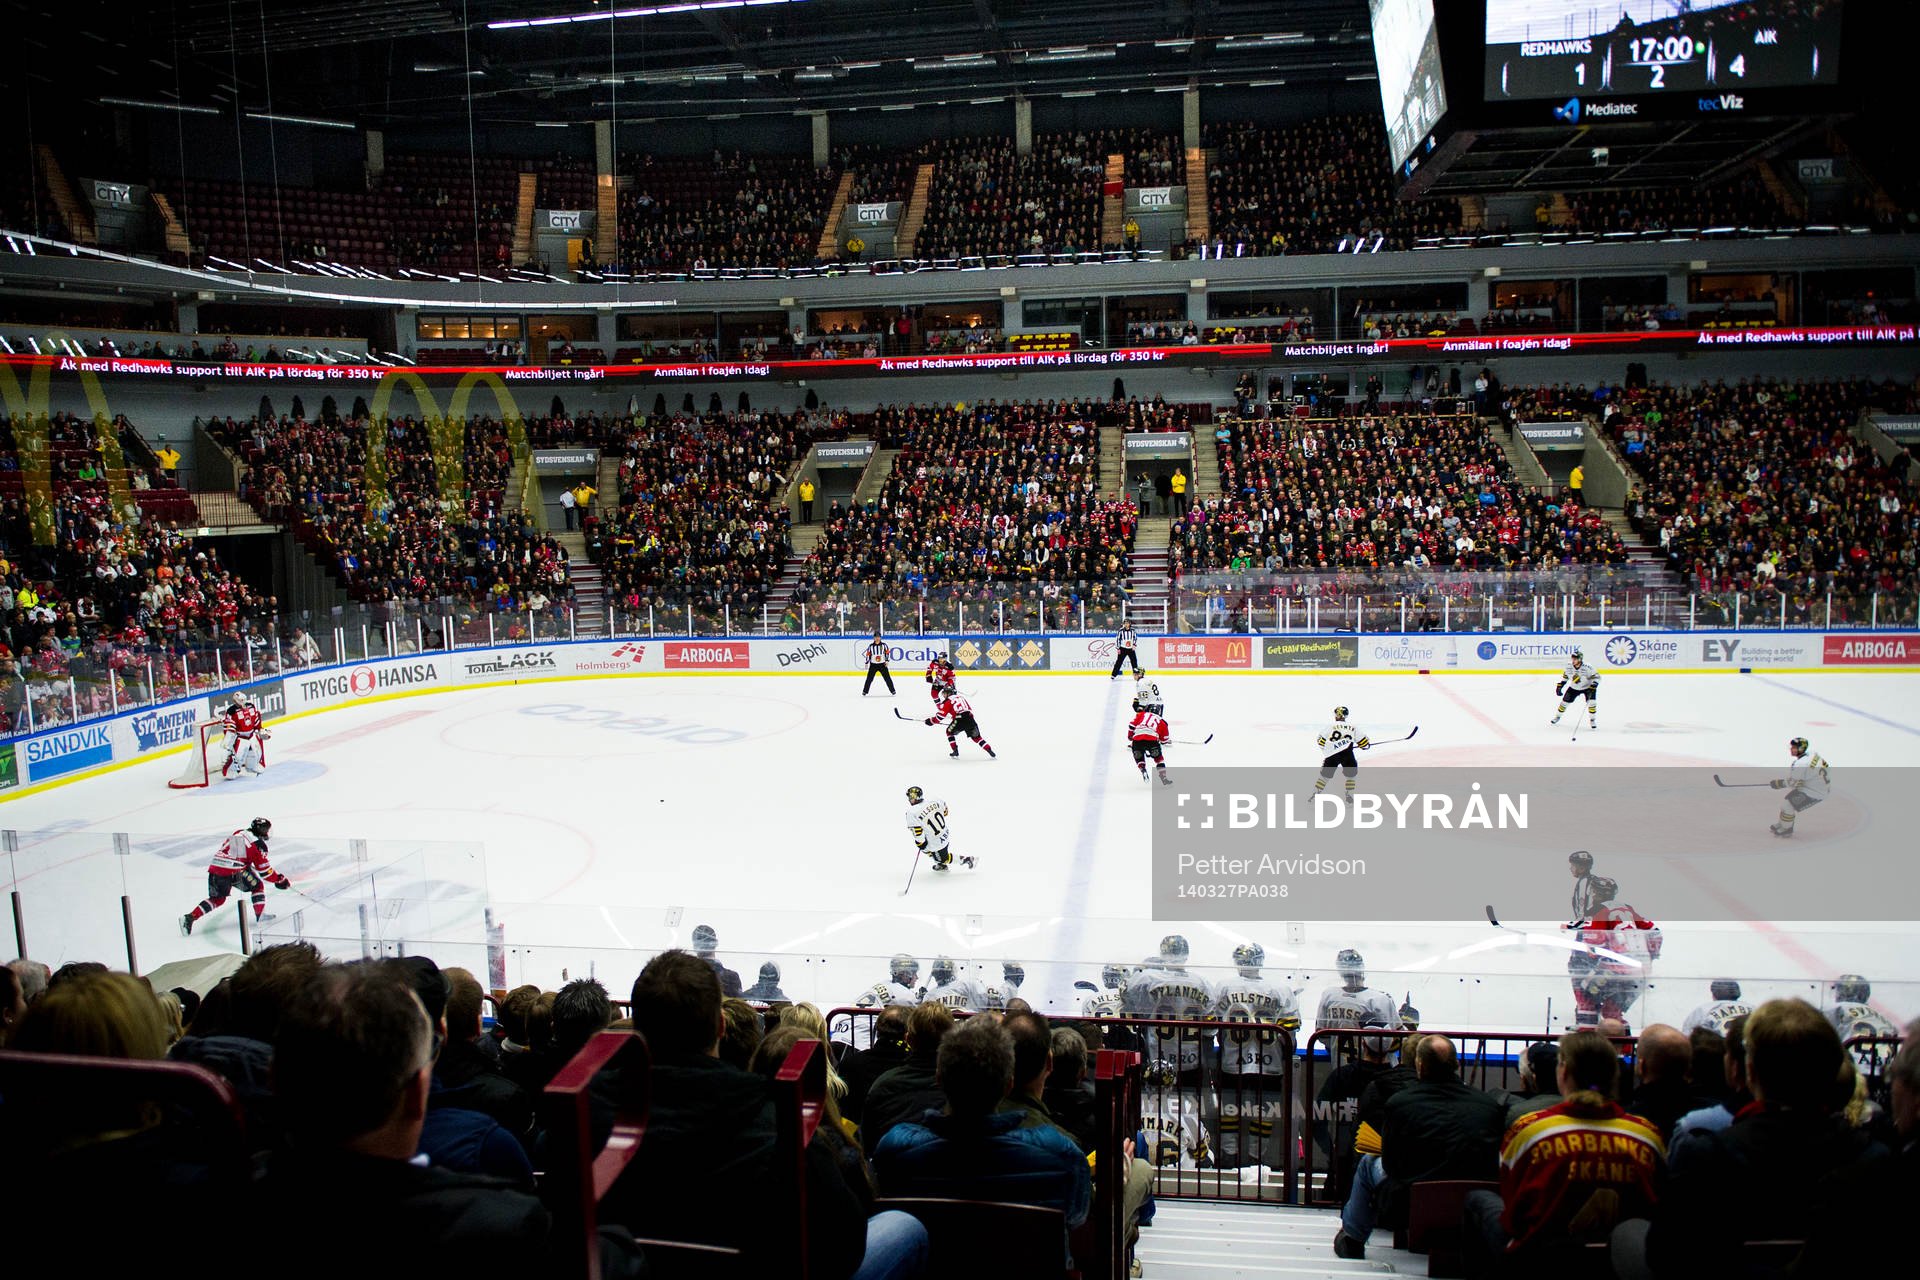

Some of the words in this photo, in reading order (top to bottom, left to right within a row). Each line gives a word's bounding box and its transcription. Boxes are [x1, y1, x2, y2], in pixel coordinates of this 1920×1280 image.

[1753, 29, 1778, 45] AIK
[1520, 40, 1592, 57] REDHAWKS
[1629, 36, 1694, 62] 17:00
[1729, 55, 1745, 77] 4
[1575, 63, 1586, 86] 1
[1651, 65, 1665, 89] 2
[1585, 101, 1638, 117] Mediatec
[97, 187, 127, 201] CITY
[1141, 193, 1168, 205] CITY
[552, 216, 578, 227] CITY
[860, 209, 885, 220] CITY
[1716, 331, 1743, 344] med
[1746, 331, 1805, 342] Redhawks
[1807, 330, 1853, 343] support
[1856, 328, 1873, 340] till
[1876, 328, 1898, 340] AIK
[1284, 342, 1354, 356] Matchbiljett
[1442, 339, 1493, 351] Anmälan
[896, 358, 920, 370] med
[922, 357, 974, 369] Redhawks
[976, 356, 1017, 370] support
[1020, 354, 1035, 366] till
[1037, 354, 1056, 365] AIK
[1058, 352, 1072, 368] på
[1074, 352, 1108, 367] lördag
[1110, 350, 1126, 363] för
[1129, 351, 1150, 362] 350
[1152, 350, 1165, 361] kr
[80, 360, 109, 373] med
[112, 361, 174, 375] Redhawks
[176, 364, 223, 378] support
[225, 364, 244, 378] till
[245, 366, 266, 378] AIK
[268, 364, 285, 380] på
[287, 366, 325, 381] lördag
[326, 366, 345, 380] för
[348, 368, 370, 380] 350
[371, 368, 384, 380] kr
[505, 368, 572, 380] Matchbiljett
[574, 367, 605, 380] ingår!
[654, 365, 700, 377] Anmälan
[708, 364, 742, 378] foajén
[744, 364, 770, 377] idag!
[1521, 430, 1572, 438] YDSVENSKAN
[1164, 642, 1176, 652] Här
[1178, 642, 1194, 652] sitter
[1194, 642, 1205, 654] jag
[1501, 644, 1582, 656] FUKTTEKNIK
[1639, 638, 1678, 652] Skåne
[1703, 639, 1741, 662] EY
[1741, 648, 1772, 656] Building
[1842, 642, 1906, 658] ARBOGA
[680, 648, 734, 662] ARBOGA
[776, 642, 828, 667] Delphi
[890, 646, 938, 662] Ocab
[958, 650, 978, 658] SOVA
[989, 650, 1010, 658] SOVA
[1020, 650, 1042, 658] SOVA
[1164, 654, 1176, 664] och
[1178, 654, 1197, 664] tänker
[1374, 646, 1432, 660] ColdZyme
[1638, 652, 1677, 663] mejerier
[1742, 655, 1772, 663] working
[576, 661, 632, 671] Holmbergs
[301, 676, 348, 702] TRYGG
[378, 664, 438, 688] HANSA
[158, 725, 180, 746] TELE
[26, 724, 110, 762] SANDVIK
[926, 811, 946, 836] 10
[1530, 1134, 1656, 1165] SPARBANKE
[1568, 1156, 1636, 1182] SKÅNE
